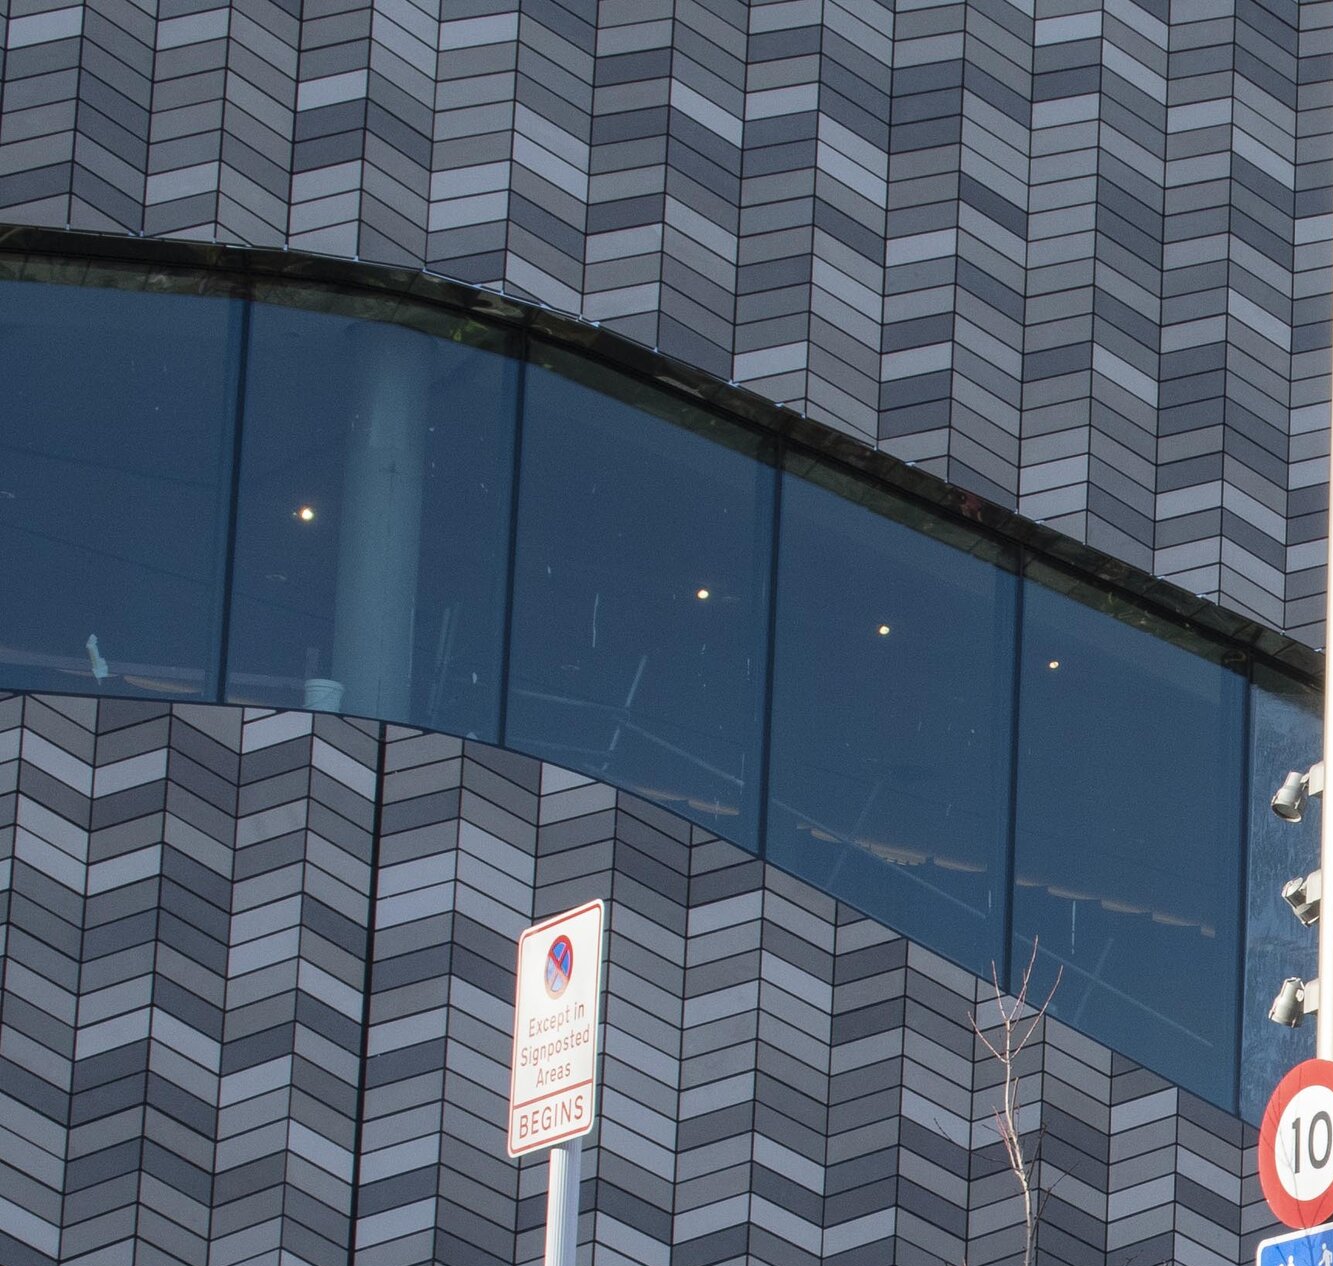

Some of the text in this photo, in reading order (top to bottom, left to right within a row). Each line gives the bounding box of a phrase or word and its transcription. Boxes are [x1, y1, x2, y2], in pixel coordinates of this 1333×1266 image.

[528, 1003, 585, 1038] Except in
[520, 1025, 590, 1067] Signposted
[536, 1063, 571, 1088] Areas
[519, 1095, 584, 1139] BEGINS
[1291, 1110, 1333, 1174] 10
